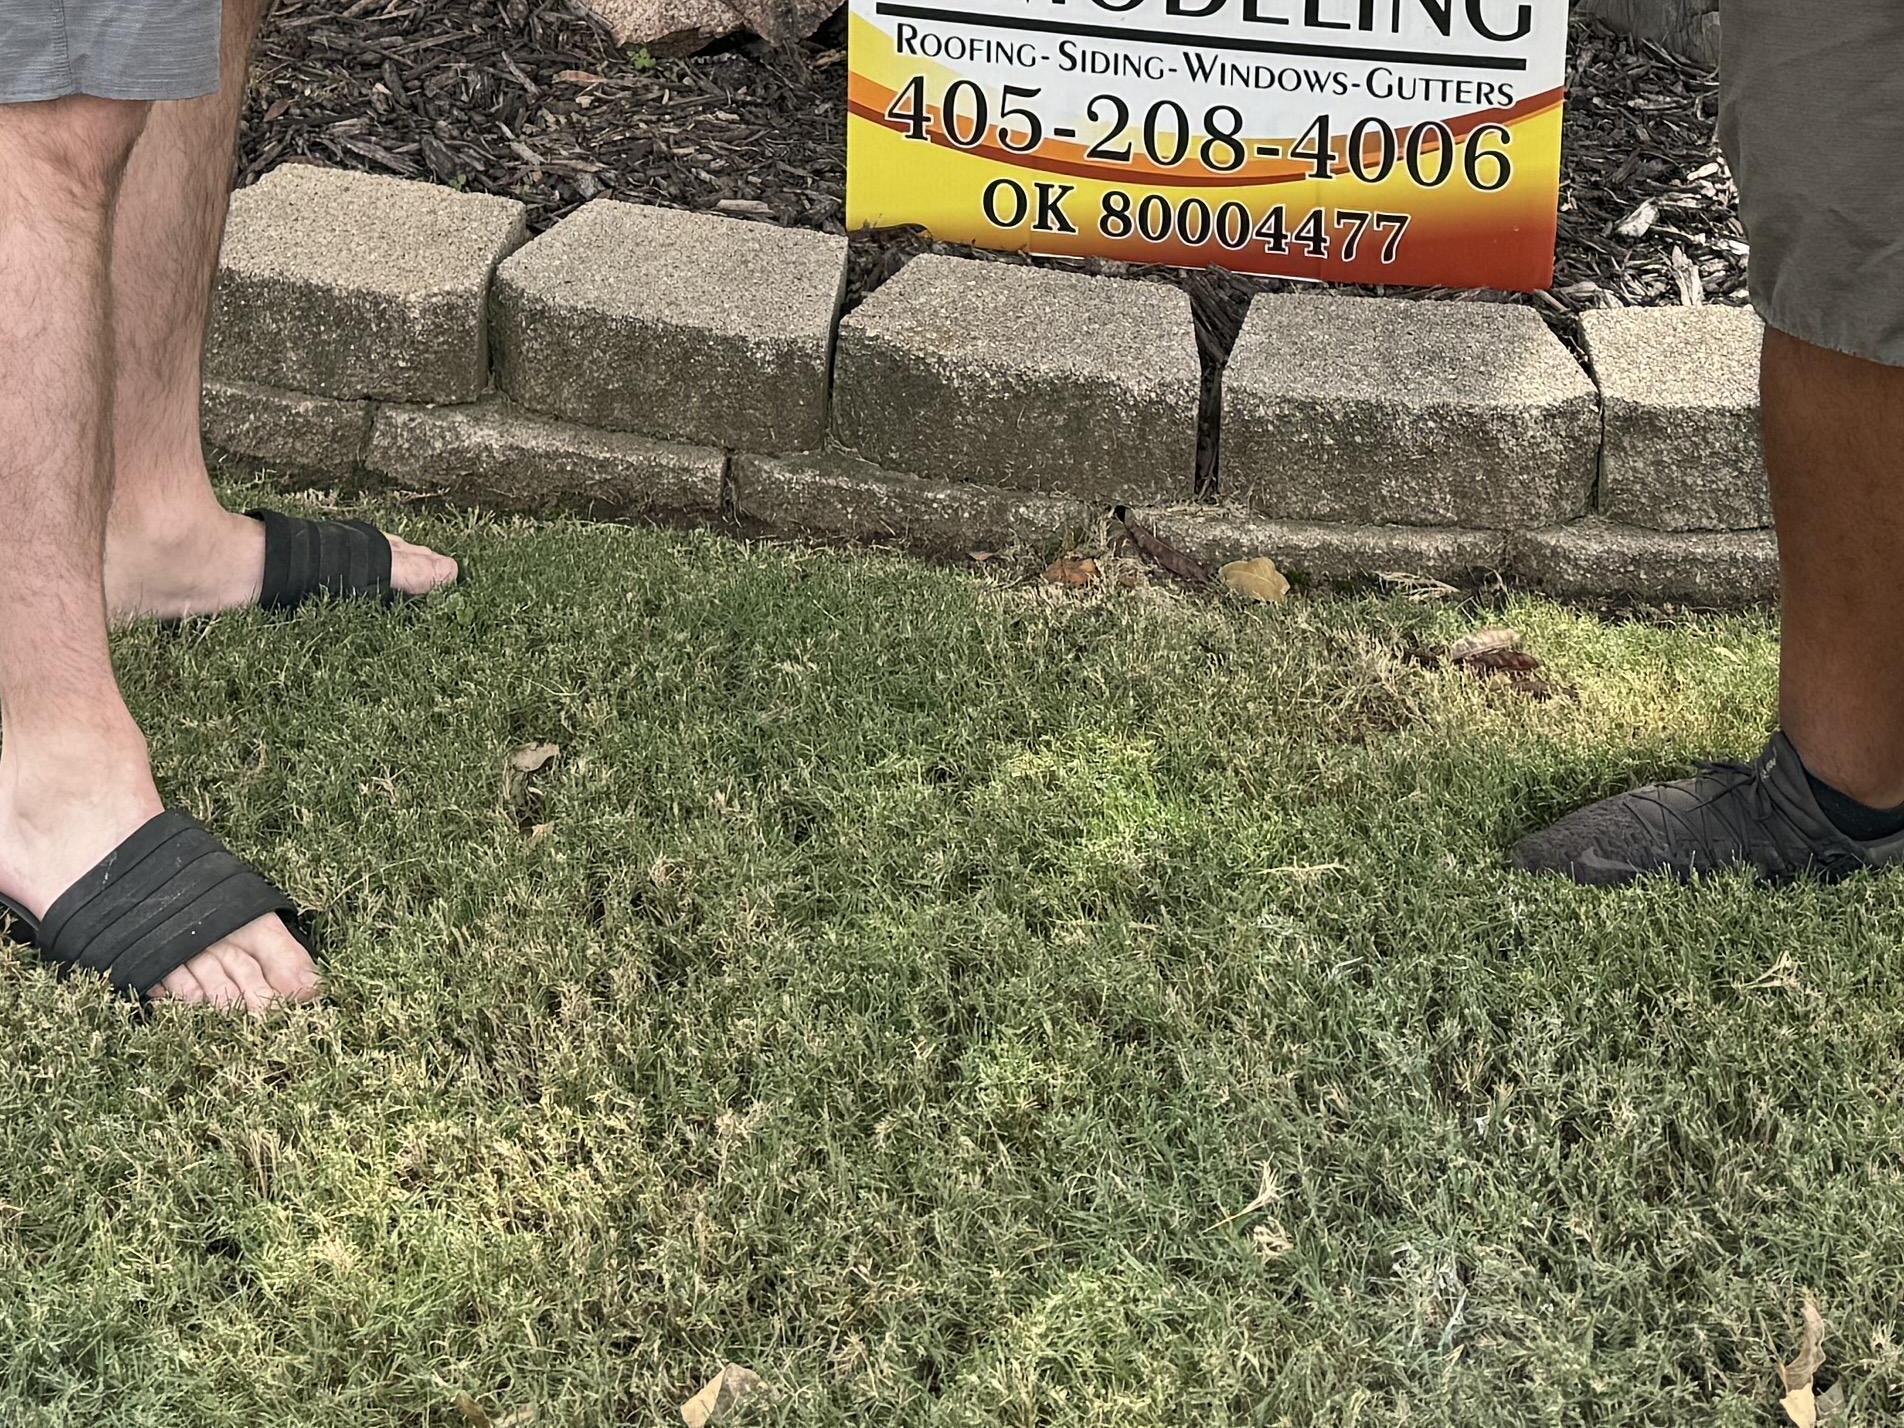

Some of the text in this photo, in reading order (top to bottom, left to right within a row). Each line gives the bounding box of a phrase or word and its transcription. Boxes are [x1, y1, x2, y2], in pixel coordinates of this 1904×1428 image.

[886, 75, 1512, 190] 405-208-4006
[983, 178, 1411, 263] OK 80004477
